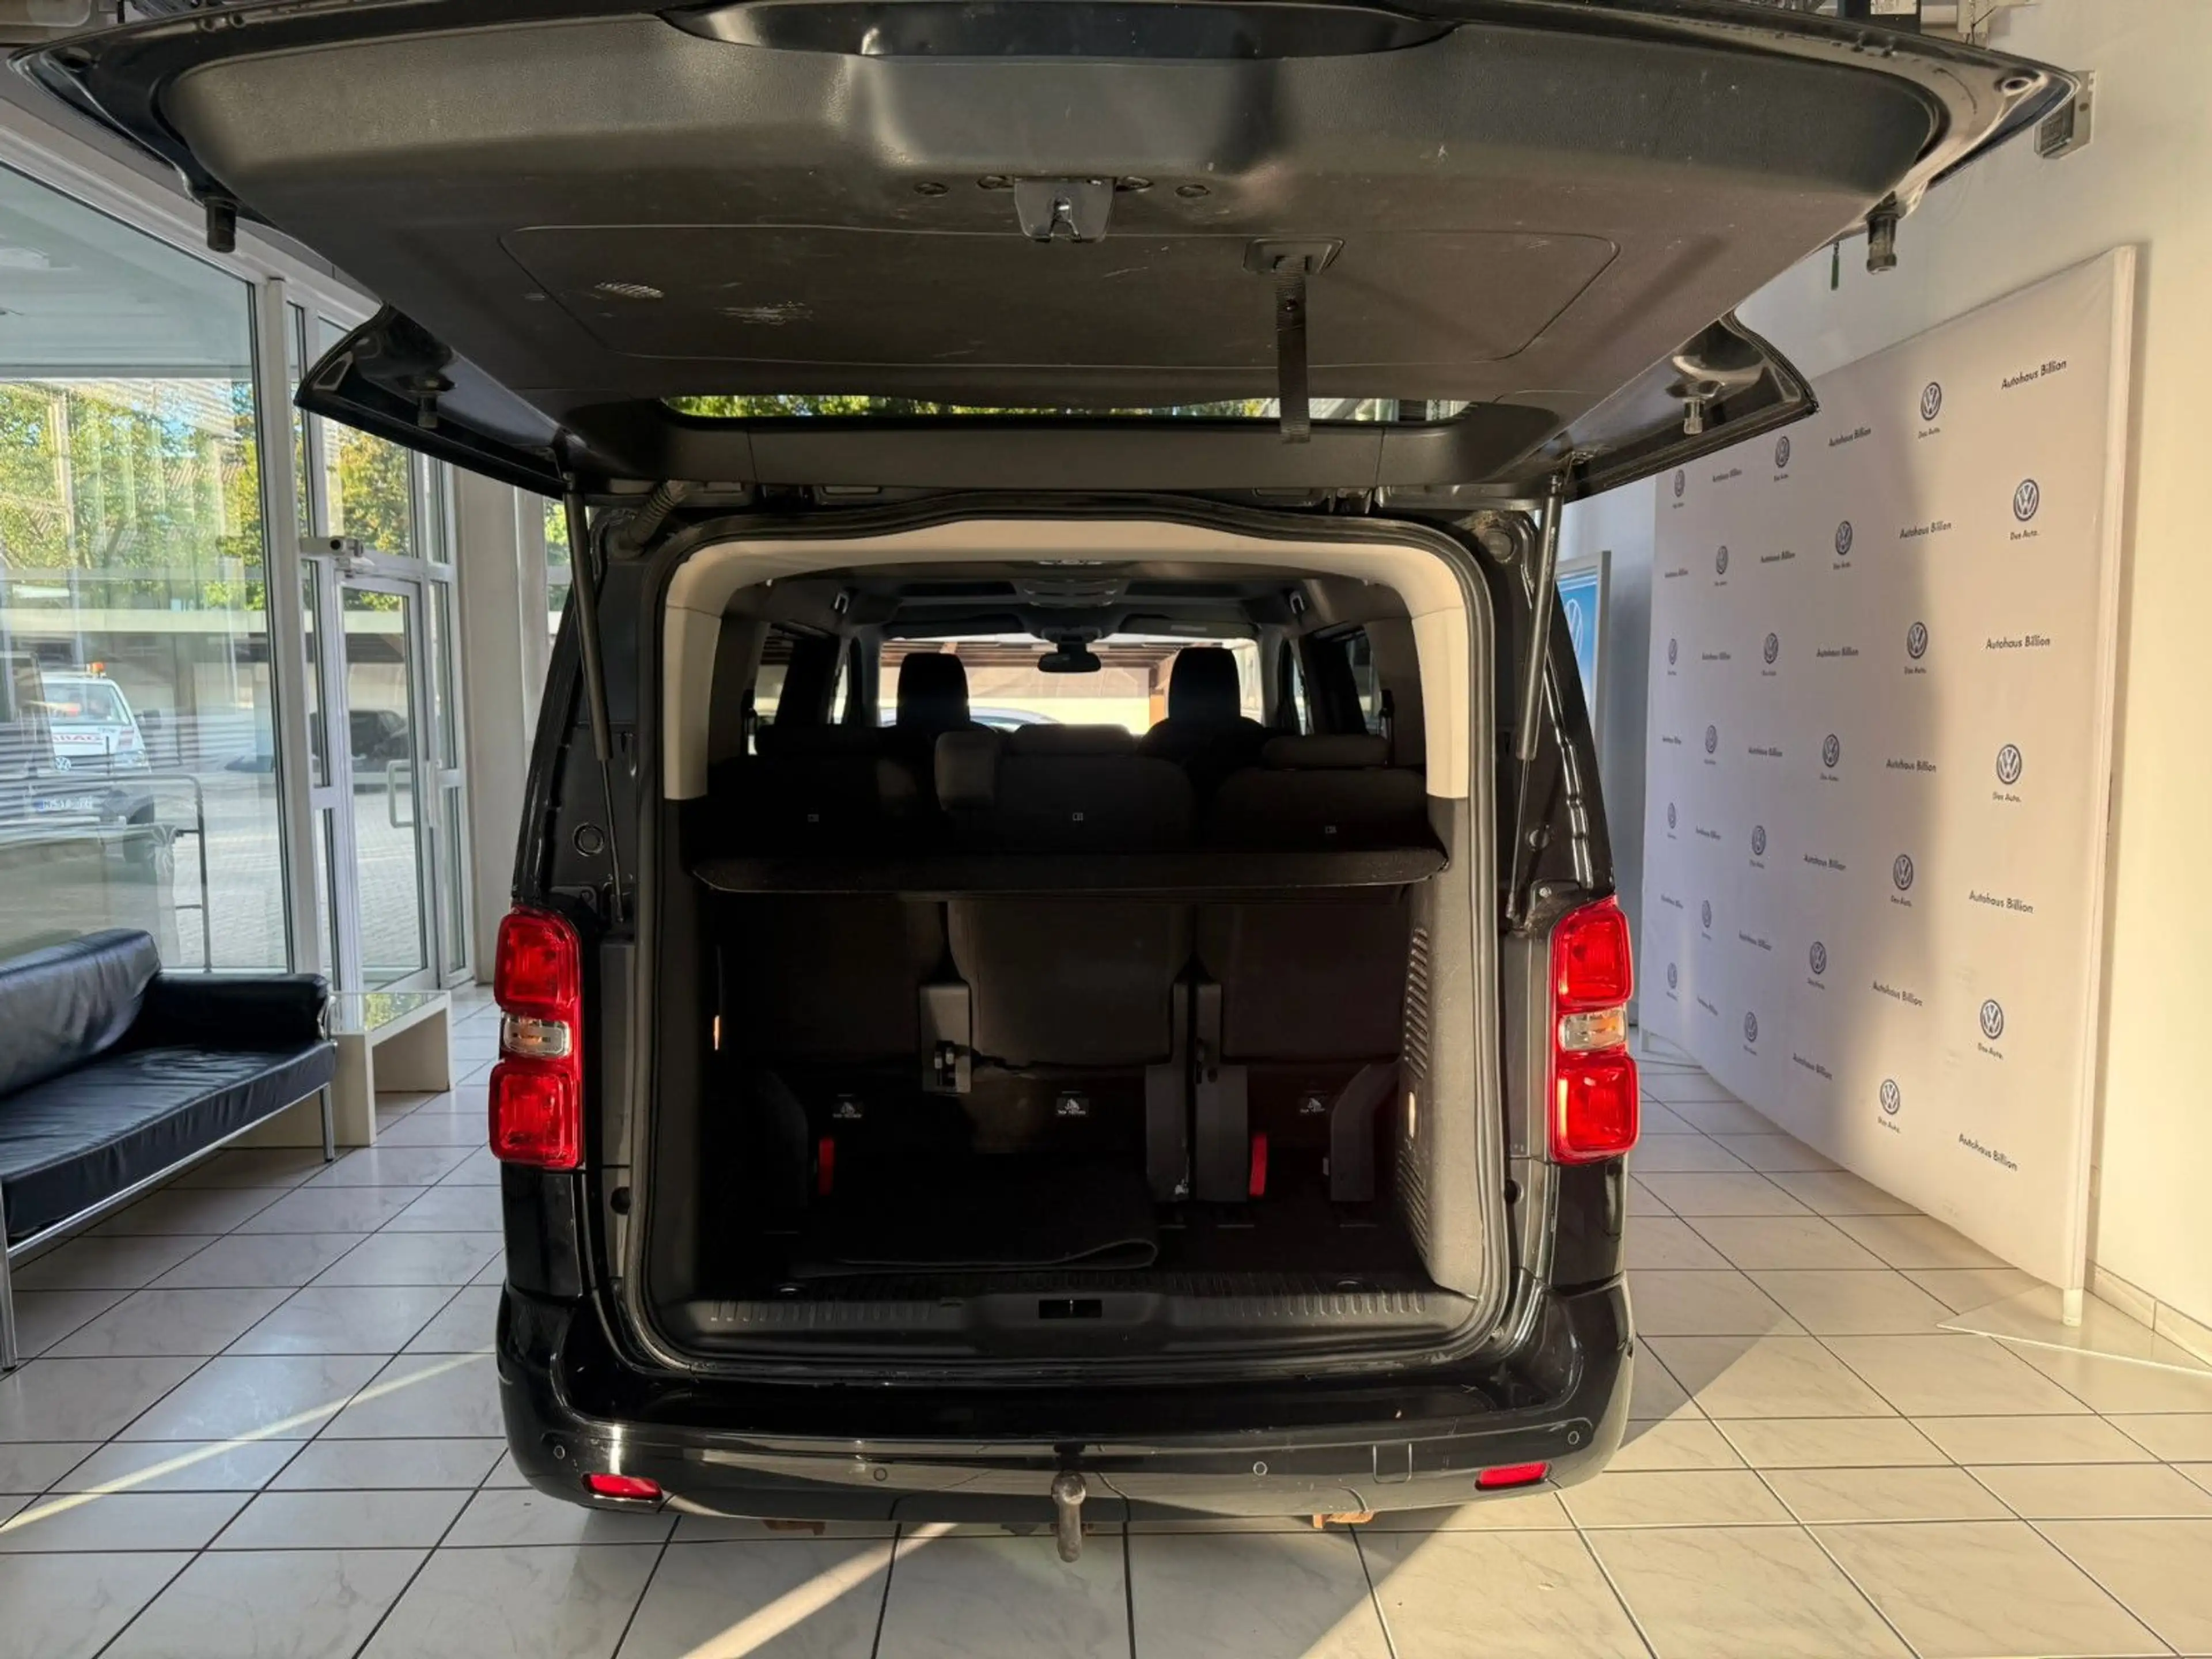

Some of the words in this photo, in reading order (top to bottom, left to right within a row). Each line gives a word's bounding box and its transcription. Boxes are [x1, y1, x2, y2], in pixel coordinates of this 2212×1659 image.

[2001, 370, 2038, 389] Autohaus
[2041, 361, 2067, 377] Billion
[2014, 479, 2039, 521] VW
[1900, 526, 1929, 539] Autohaus
[1931, 521, 1953, 533] Billion
[1986, 637, 2022, 649] Autohaus
[2025, 634, 2051, 647] Billion
[1997, 744, 2021, 785] VW
[1969, 890, 2005, 908] Autohaus
[2006, 897, 2035, 914] Billion
[1981, 999, 2003, 1040] VW
[1881, 1080, 1900, 1115] VW
[1959, 1133, 1991, 1158] Autohaus
[1993, 1150, 2020, 1172] Billion
